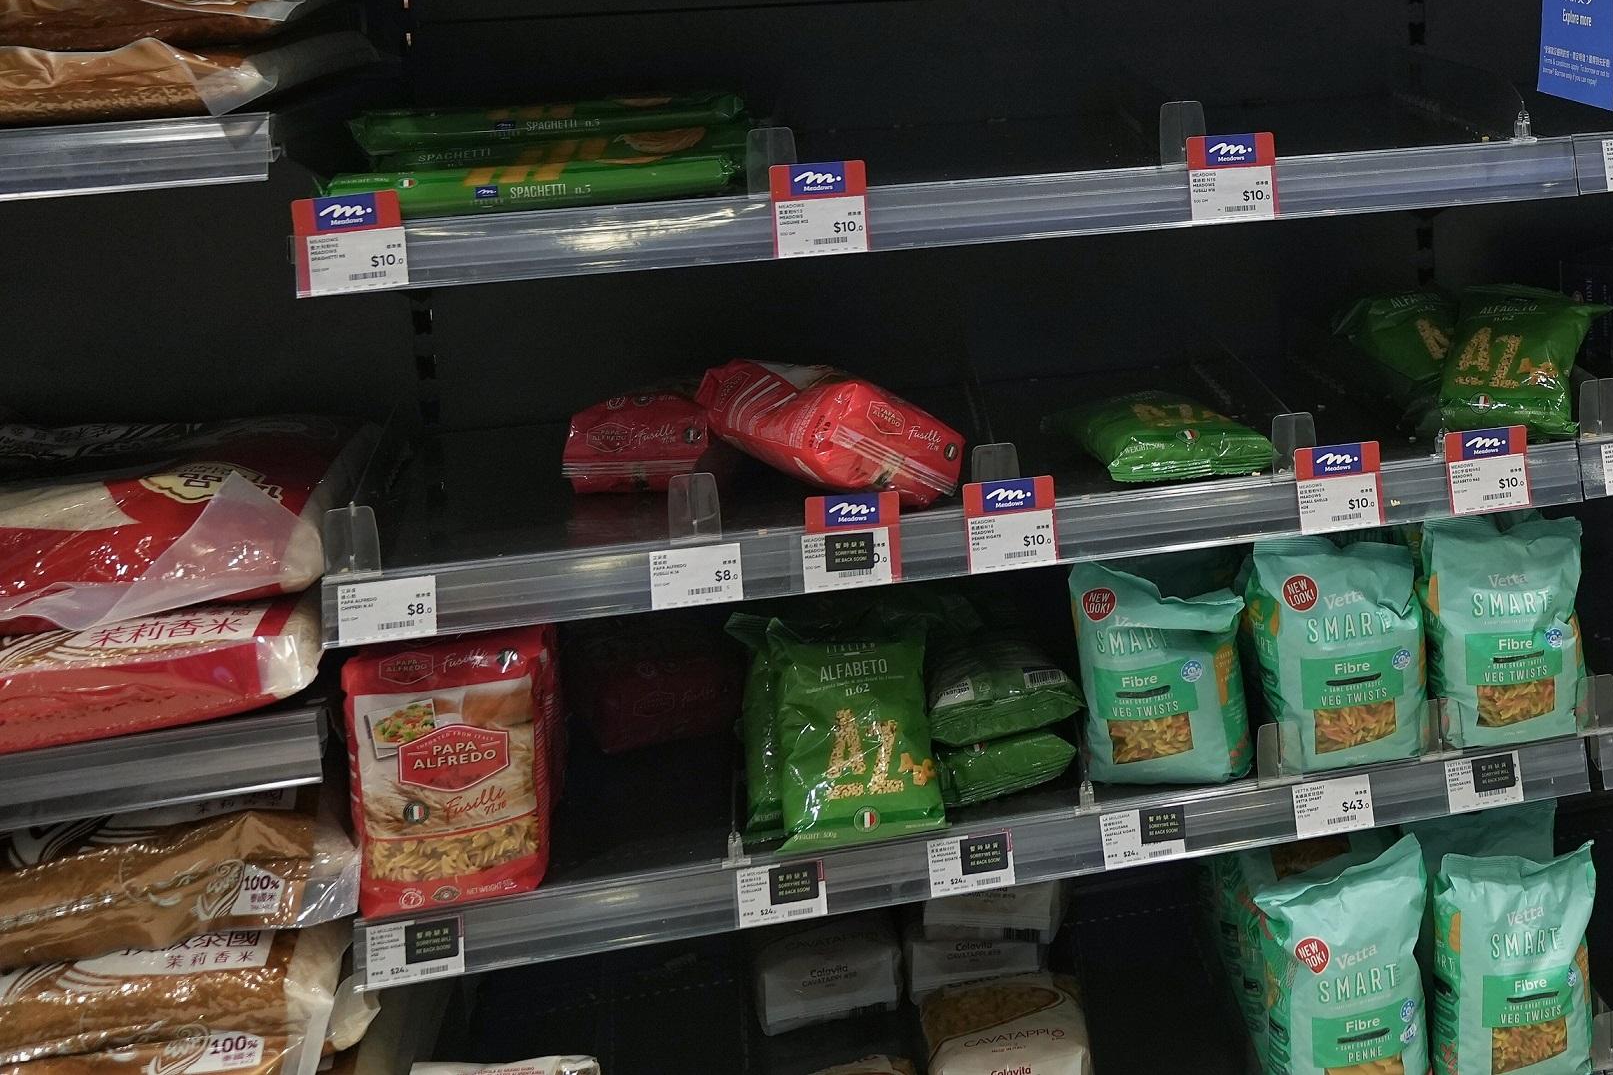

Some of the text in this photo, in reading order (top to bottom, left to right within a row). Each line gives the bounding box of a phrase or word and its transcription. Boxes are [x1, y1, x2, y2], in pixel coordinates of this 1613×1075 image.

[1563, 9, 1591, 27] Explore more
[510, 184, 567, 200] SPAGHETTI
[330, 217, 364, 226] Meadows
[371, 254, 404, 268] $10.0
[995, 500, 1023, 508] Meadows
[1023, 534, 1051, 547] $10.0
[1286, 577, 1310, 598] NEW
[1487, 572, 1529, 590] Vetta
[1288, 590, 1318, 608] LOOK!
[1471, 587, 1550, 617] SMART
[407, 602, 433, 616] $8.0
[90, 617, 243, 647] 茉莉香米
[1305, 611, 1386, 645] SMART
[1498, 636, 1534, 652] Fibre
[819, 658, 889, 683] ALFABETO
[1333, 658, 1371, 675] Fibre
[845, 683, 870, 698] n.62
[1320, 685, 1388, 707] VEG TWISTS
[432, 741, 477, 756] PAPA
[412, 748, 497, 770] ALFREDO
[442, 786, 505, 820] Fusilli
[1342, 800, 1369, 812] $43.0
[242, 874, 280, 892] 100%
[166, 950, 256, 969] 茉莉香米
[1334, 942, 1378, 970] Vetta
[1318, 963, 1398, 1004] SMART
[1344, 1015, 1381, 1031] Fibre
[1346, 1046, 1383, 1063] PENNE
